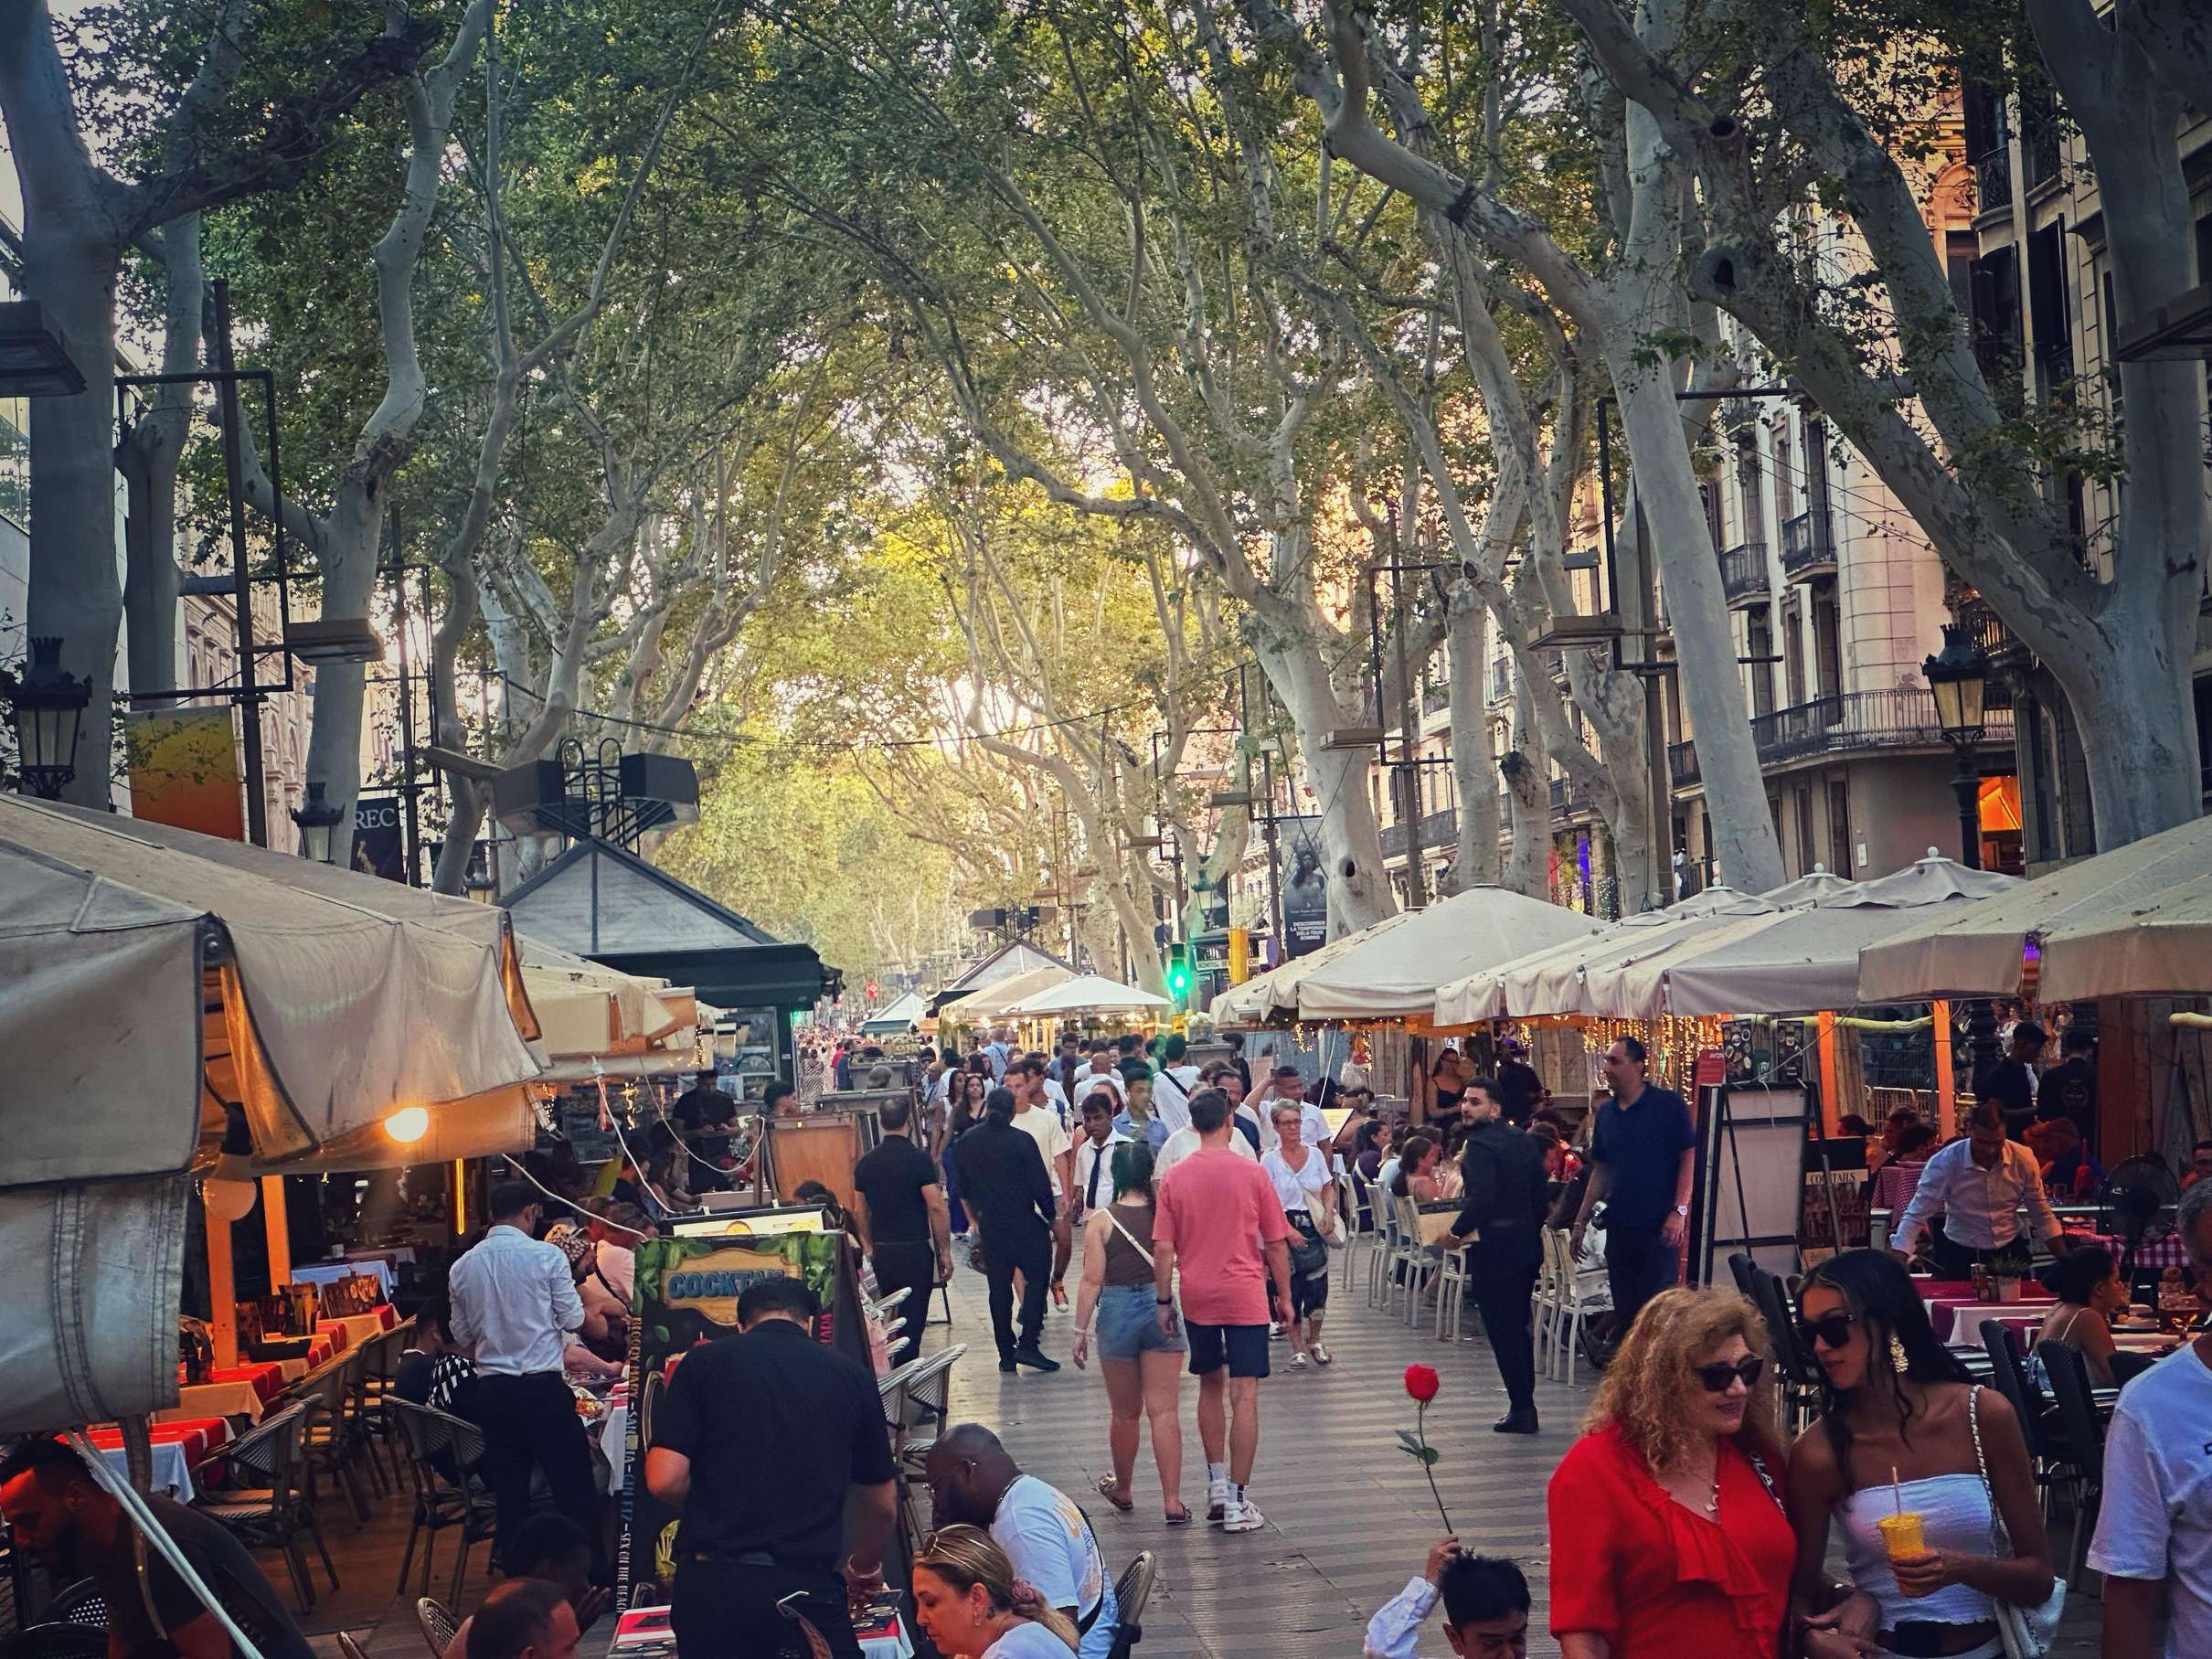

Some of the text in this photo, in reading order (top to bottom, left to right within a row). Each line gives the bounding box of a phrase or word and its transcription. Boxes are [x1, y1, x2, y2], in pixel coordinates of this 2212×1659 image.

[1811, 1173, 1856, 1184] COTAILS
[668, 1268, 784, 1300] COCKT
[629, 1315, 643, 1359] BLOODY
[628, 1365, 641, 1398] MARY
[624, 1410, 638, 1463] SANIA
[622, 1474, 635, 1495] GIN
[620, 1532, 632, 1550] SEX
[618, 1551, 631, 1565] ON
[617, 1566, 630, 1584] THE
[616, 1585, 629, 1613] BEACH
